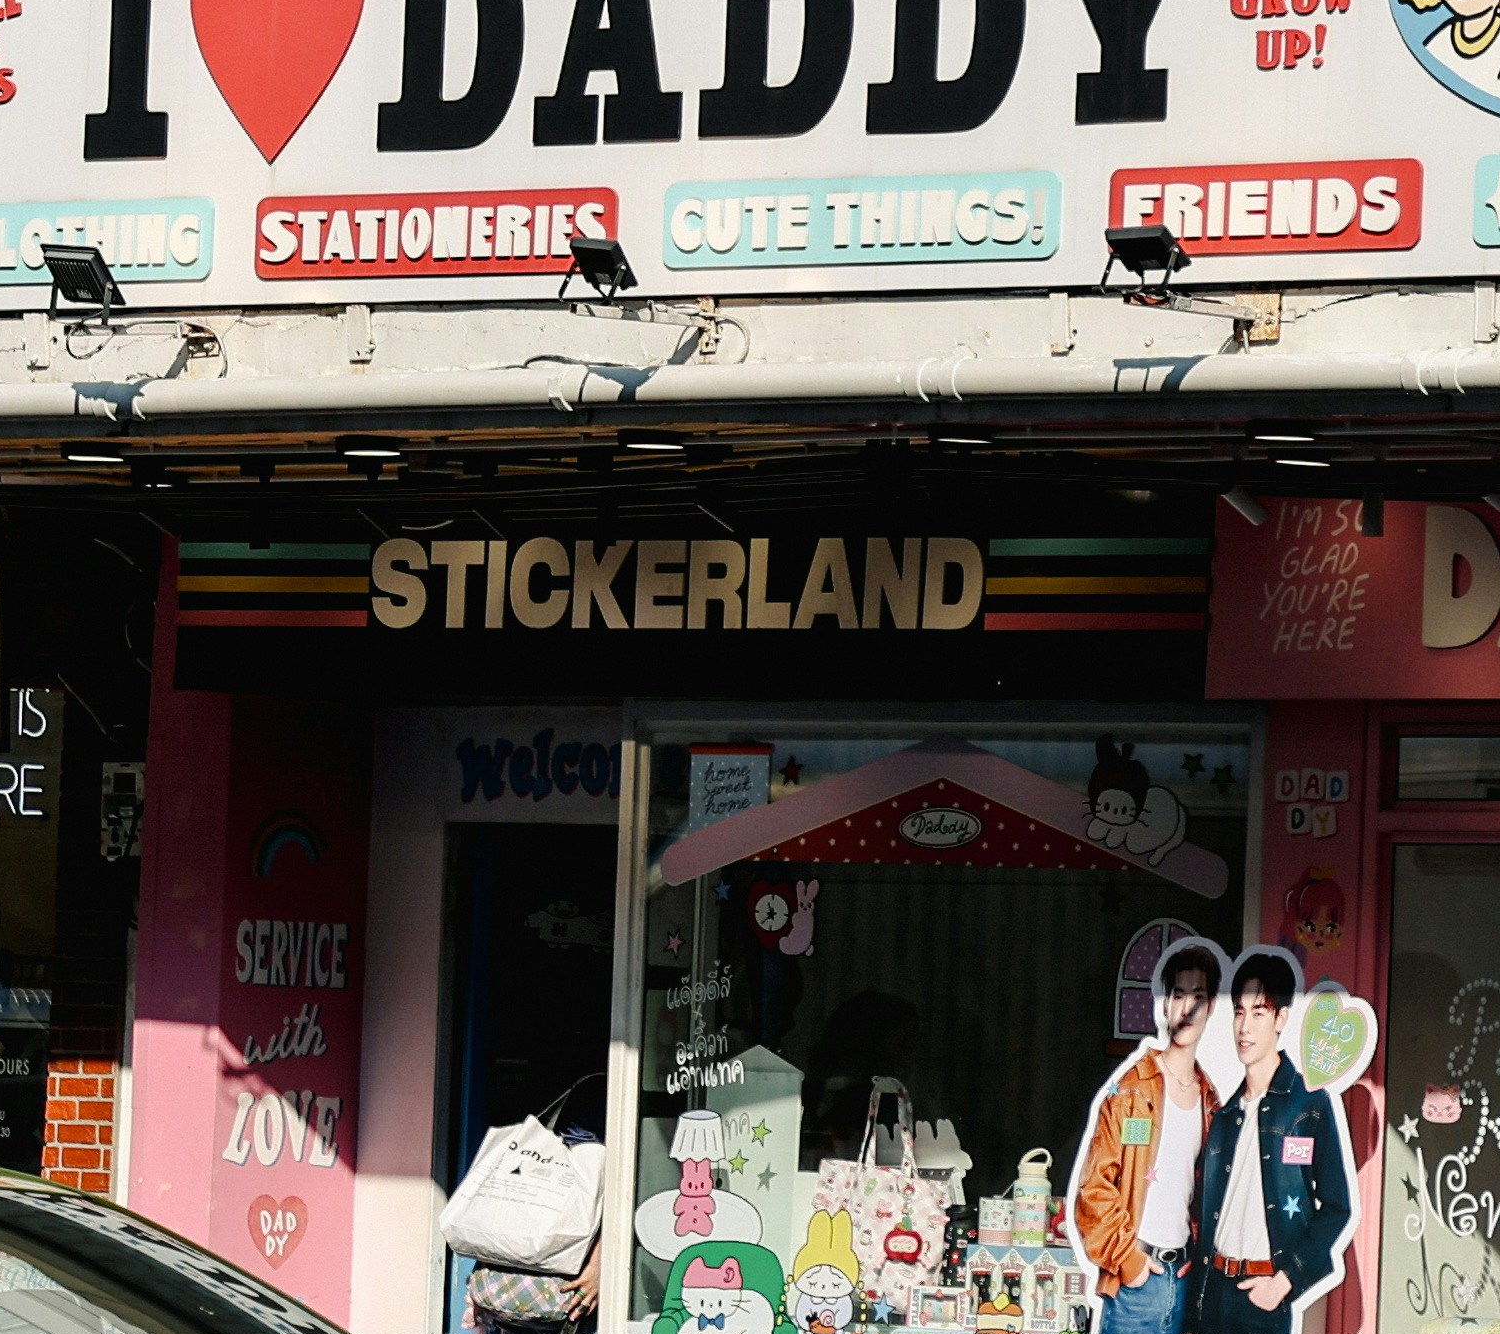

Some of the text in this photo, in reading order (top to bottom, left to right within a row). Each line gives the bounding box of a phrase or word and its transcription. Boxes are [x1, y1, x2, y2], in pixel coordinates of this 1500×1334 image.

[1255, 23, 1325, 71] UP!
[670, 183, 1046, 254] CUTE THINGS!
[1122, 176, 1400, 241] FRIENDS
[260, 200, 606, 265] STATIONERIES
[1276, 501, 1323, 540] I'M
[1280, 542, 1360, 579] GLAD
[369, 536, 984, 631] STICKERLAND
[1260, 573, 1370, 620] YOU'RE
[1273, 616, 1357, 654] HERE
[704, 762, 751, 784] home
[704, 796, 752, 816] home
[911, 811, 972, 839] Daddy
[235, 919, 350, 991] SERVICE
[242, 1004, 328, 1067] with
[1320, 1015, 1355, 1043] 40
[222, 1089, 344, 1168] LOVE
[1286, 1142, 1311, 1159] Por
[260, 1208, 298, 1233] DAD
[266, 1234, 291, 1258] DY
